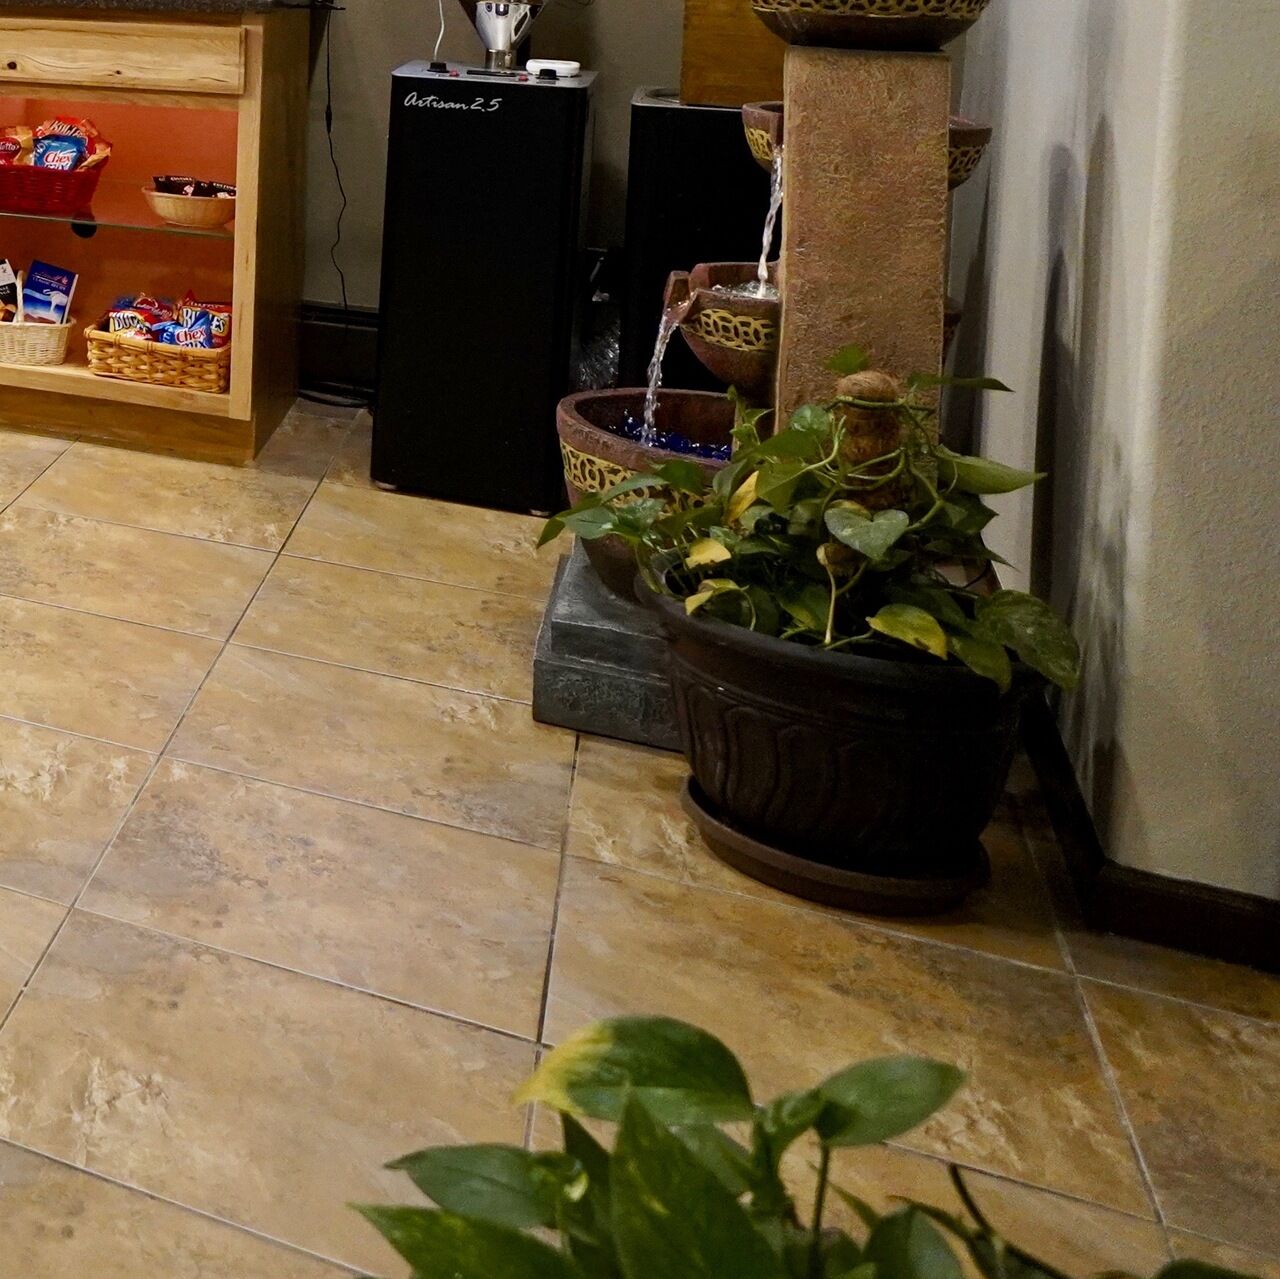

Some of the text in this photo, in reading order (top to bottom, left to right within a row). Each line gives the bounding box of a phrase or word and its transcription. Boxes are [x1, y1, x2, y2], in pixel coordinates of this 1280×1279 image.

[404, 91, 503, 112] Artisan 2.5
[175, 327, 207, 344] Chex
